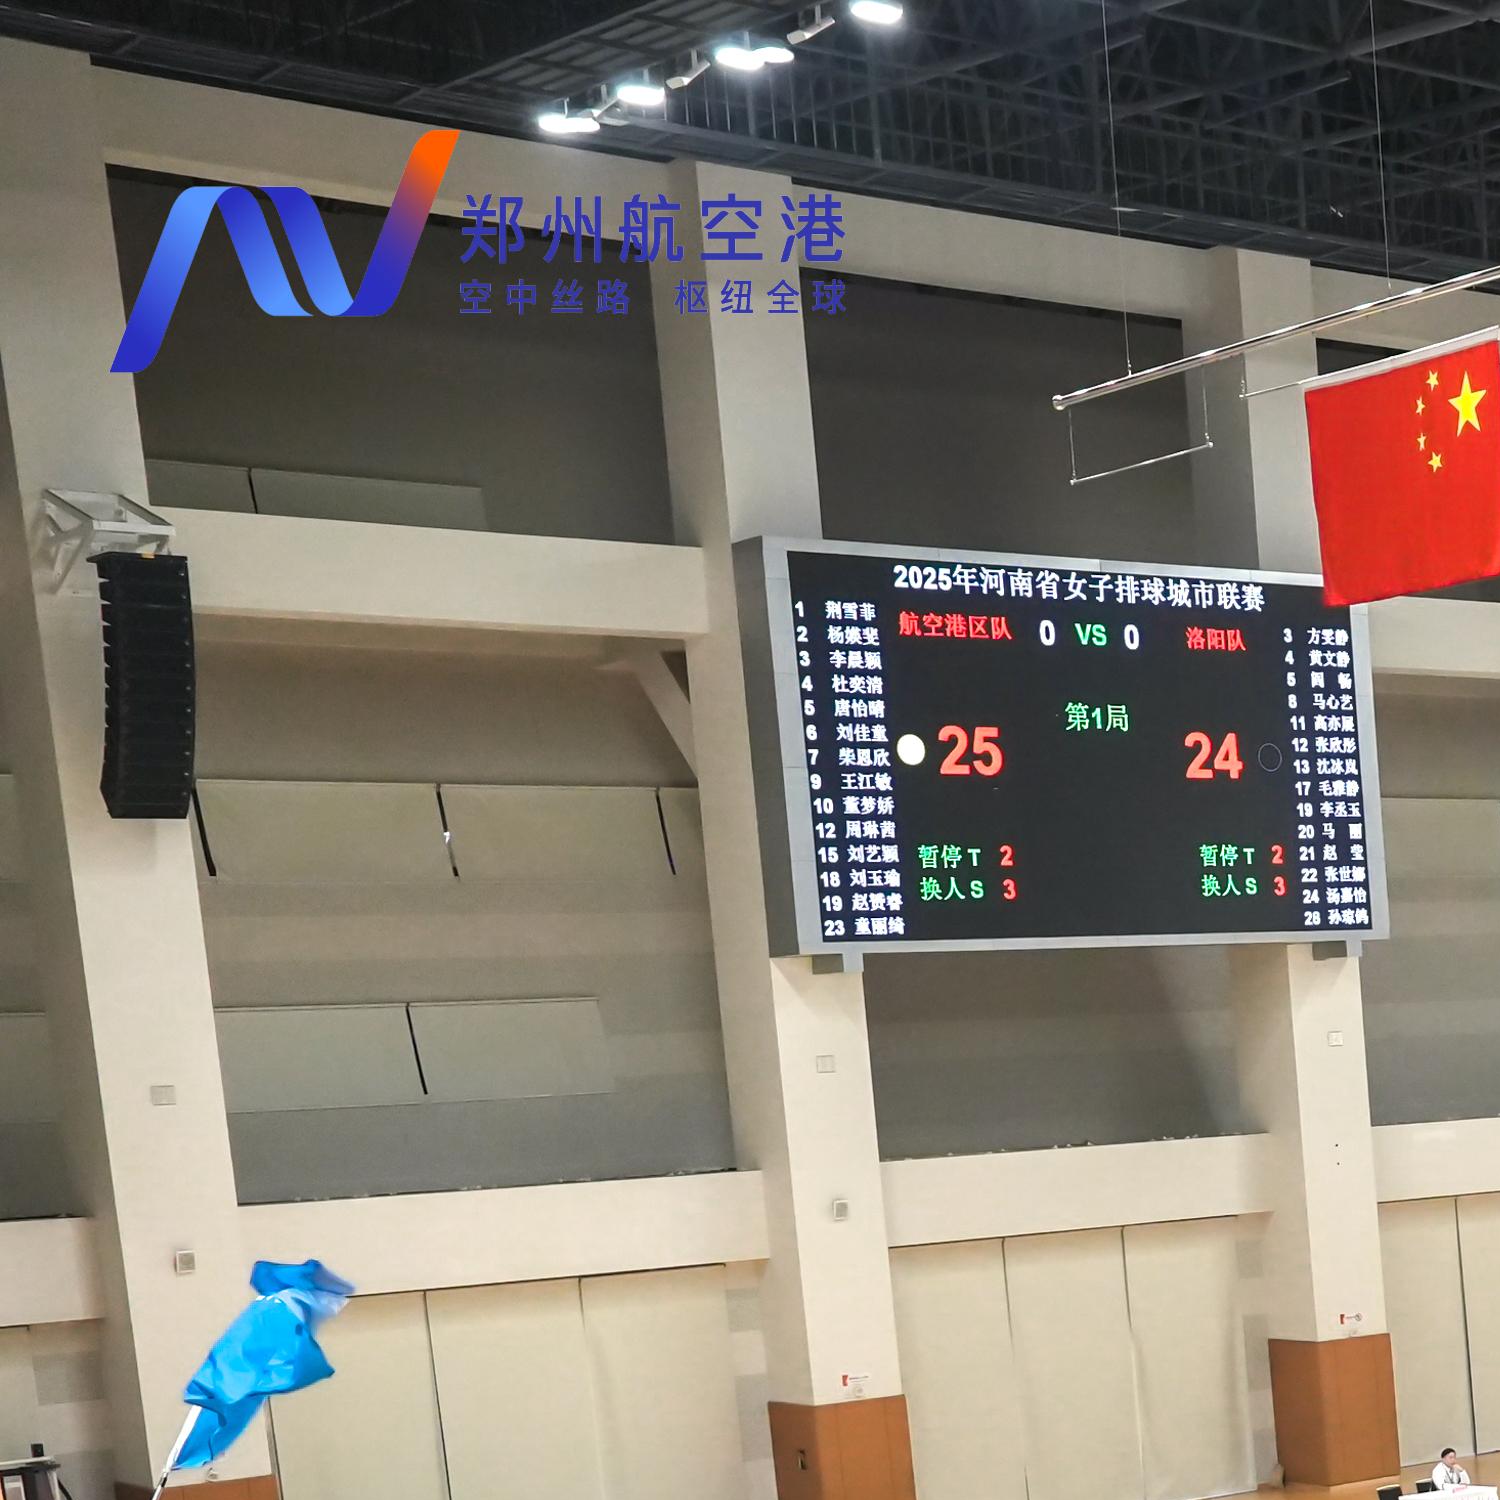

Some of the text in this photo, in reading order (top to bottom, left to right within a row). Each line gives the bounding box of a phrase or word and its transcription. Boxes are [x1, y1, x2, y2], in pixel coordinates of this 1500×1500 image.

[893, 564, 1265, 612] 2025年河南省女子排球城市联赛
[795, 601, 804, 617] 1
[797, 626, 808, 642] 2
[898, 611, 1247, 651] 航空港区队 0 VS 0 洛阳队
[1283, 628, 1292, 642] 3
[799, 651, 811, 666] 3
[1285, 650, 1294, 665] 4
[801, 675, 813, 692] 4
[804, 700, 815, 715] 5
[1064, 702, 1130, 732] 第1局
[1290, 716, 1305, 731] 11
[806, 725, 817, 740] 6
[937, 725, 1003, 776] 25
[1292, 738, 1308, 752] 12
[808, 749, 819, 765] 7
[1183, 731, 1244, 779] 24
[1294, 760, 1310, 774] 13
[810, 773, 822, 790] 9
[1295, 782, 1311, 796] 17
[813, 798, 834, 814] 10
[1296, 803, 1313, 817] 19
[816, 823, 836, 838] 12
[1298, 825, 1315, 839] 20
[818, 847, 839, 863] 15
[918, 844, 1014, 869] 暂停 T 2
[1199, 844, 1284, 867] 暂停 T 2
[1299, 846, 1315, 861] 21
[820, 871, 841, 887] 18
[1301, 868, 1318, 882] 22
[919, 876, 1017, 900] 换人 S 3
[1201, 873, 1287, 896] 换人 S 3
[823, 896, 843, 911] 19
[1303, 889, 1319, 904] 24
[824, 920, 845, 936] 23
